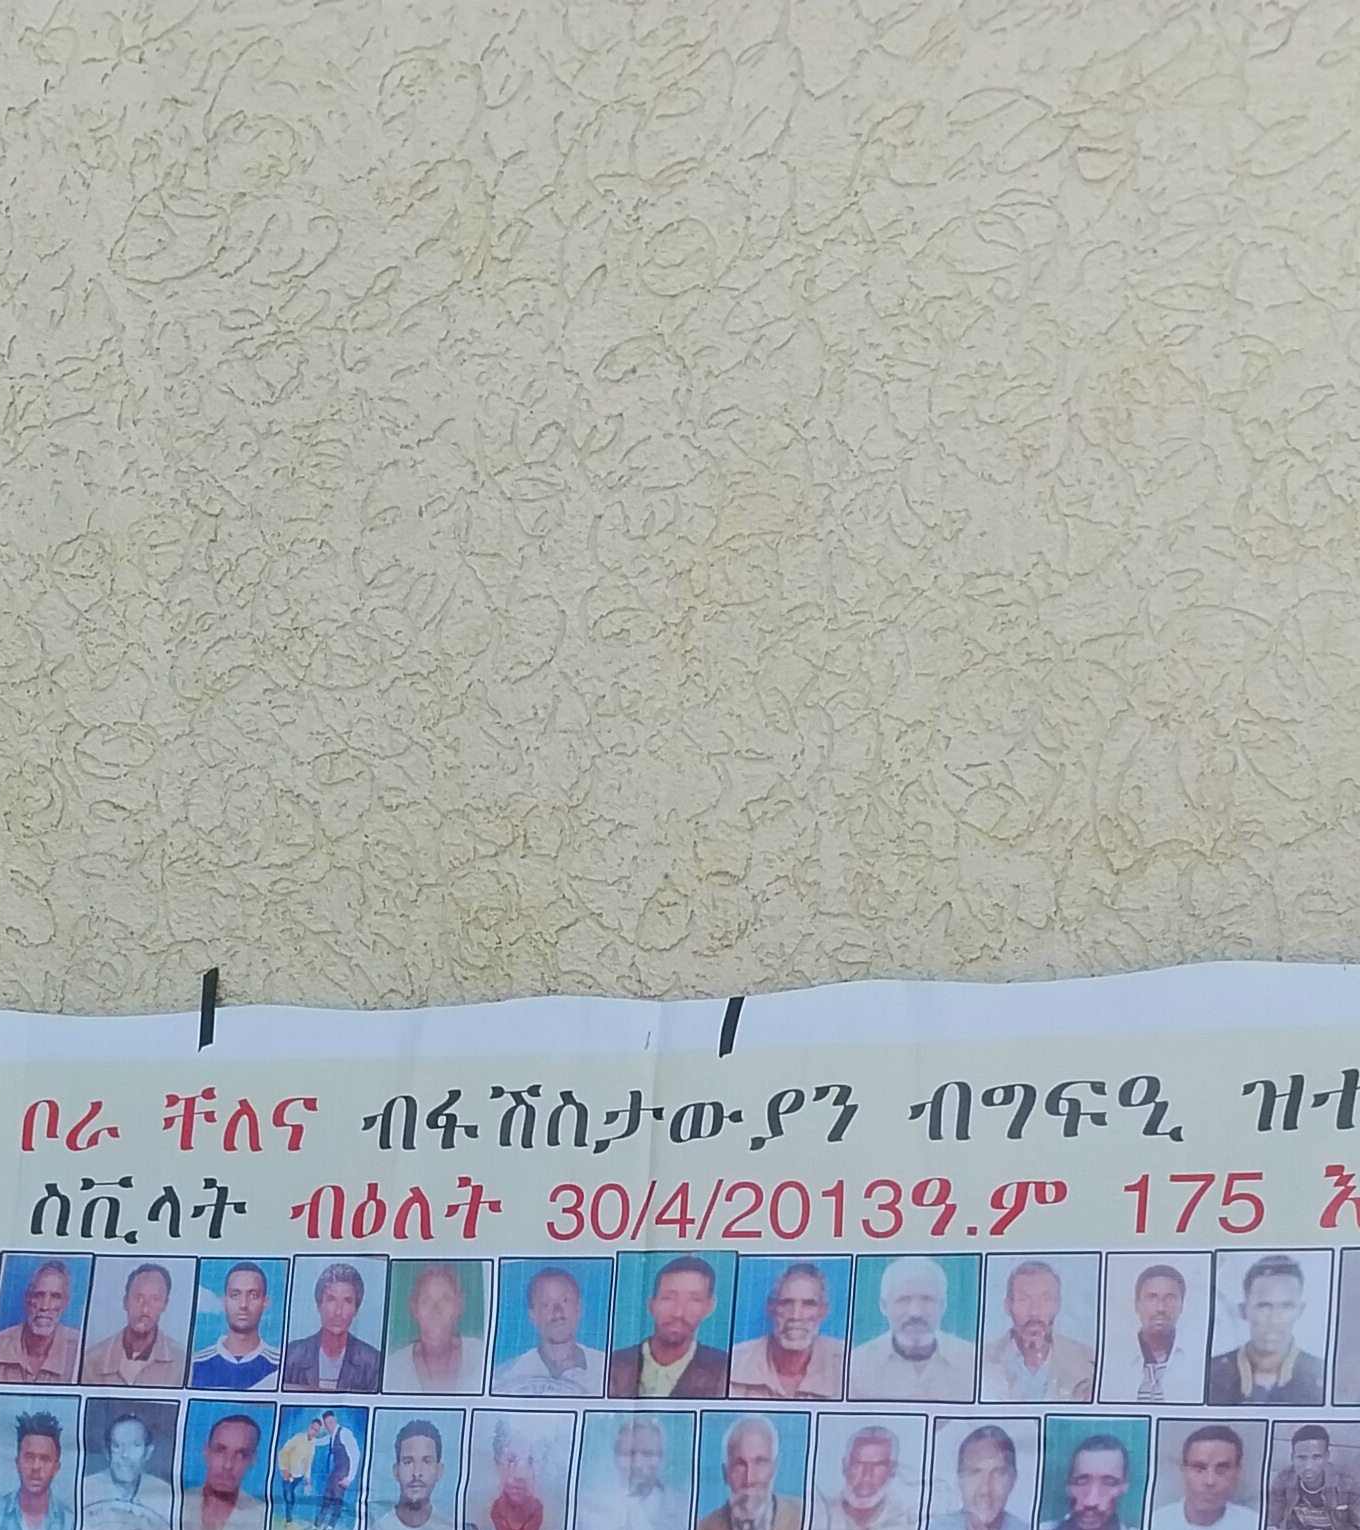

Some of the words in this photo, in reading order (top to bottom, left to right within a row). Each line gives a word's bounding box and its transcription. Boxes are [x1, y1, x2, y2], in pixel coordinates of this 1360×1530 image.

[21, 1099, 120, 1152] ቦራ
[163, 1087, 318, 1152] ቸለና
[361, 1084, 859, 1154] ብፋሽስታውያን
[908, 1075, 1184, 1142] ብግፍዒ
[30, 1174, 247, 1245] ስቪላት
[290, 1175, 502, 1241] ብዕለት
[1123, 1171, 1266, 1235] 175
